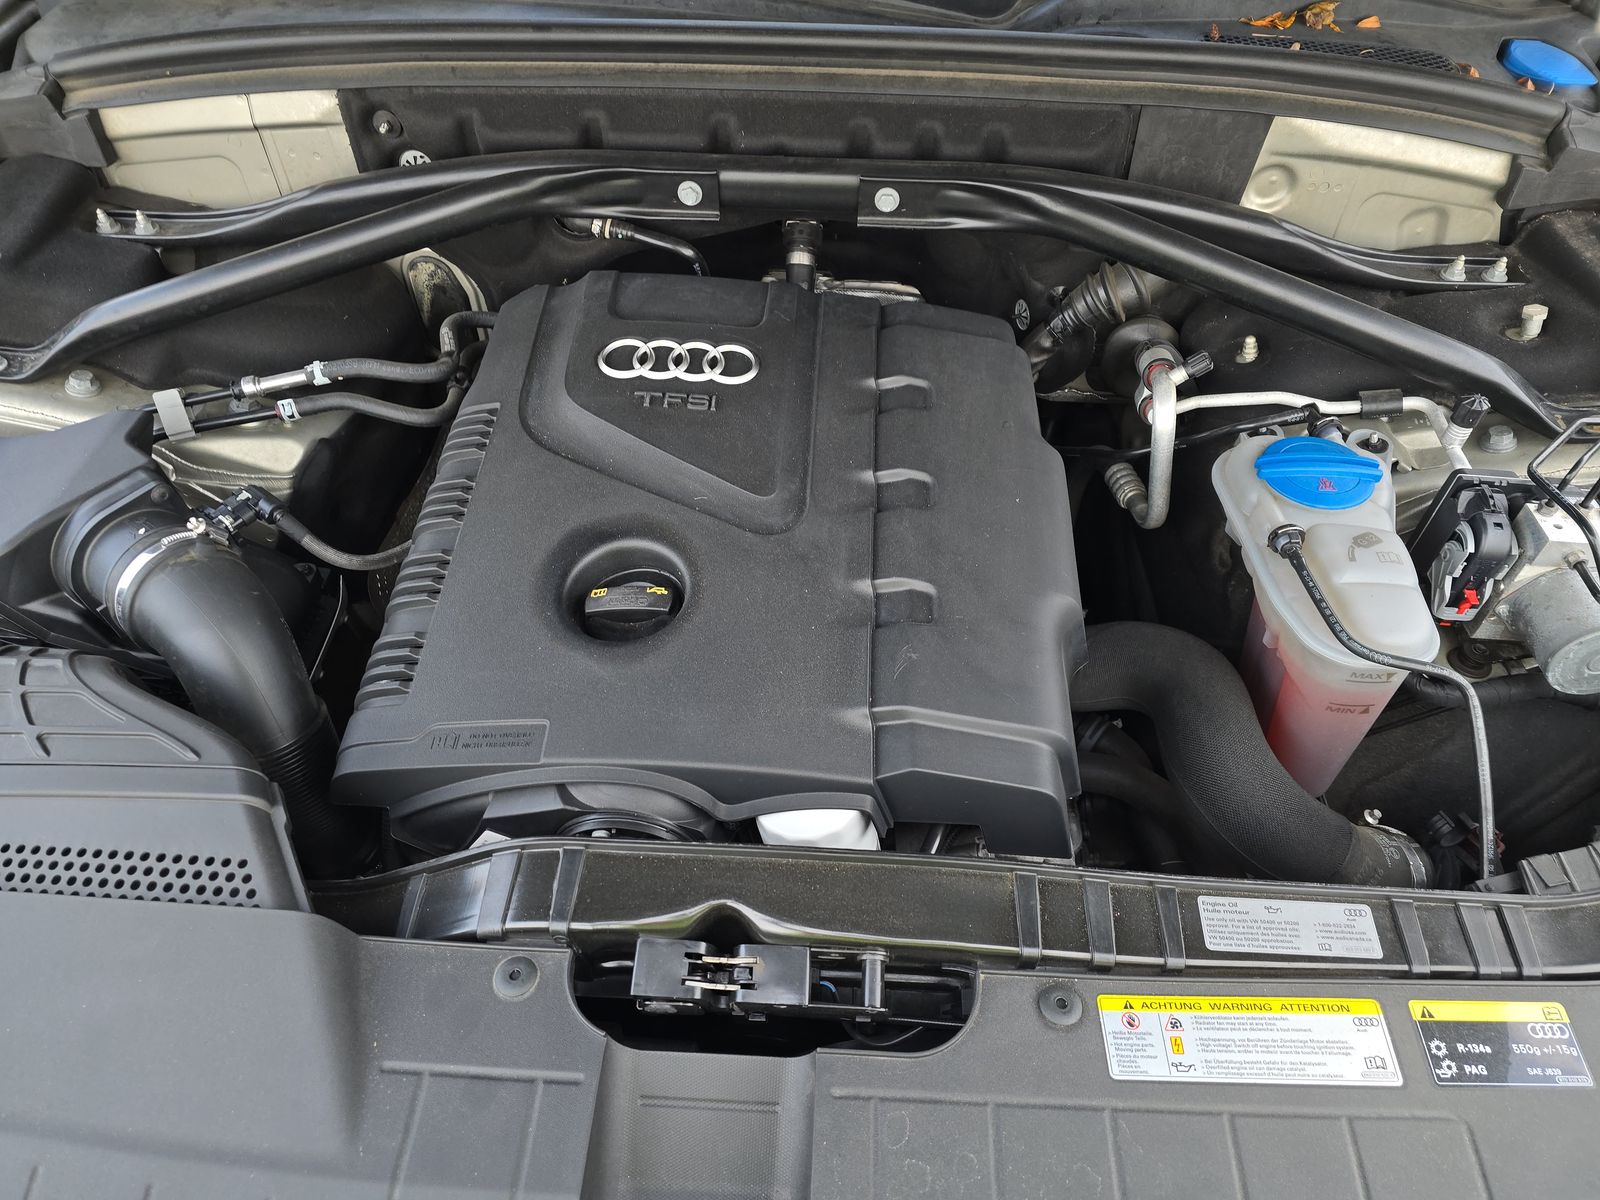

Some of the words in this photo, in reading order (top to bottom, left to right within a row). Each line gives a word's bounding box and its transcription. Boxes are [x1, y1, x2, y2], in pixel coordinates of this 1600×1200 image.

[634, 392, 716, 412] TFSI
[1350, 672, 1385, 680] MAX
[1325, 705, 1357, 714] MIN
[1202, 900, 1226, 908] Engine
[1140, 1001, 1202, 1010] ACHTUNG
[1208, 1002, 1272, 1011] WARNING
[1280, 1003, 1350, 1012] ATTENTION
[1456, 1043, 1492, 1054] R-134a
[1511, 1044, 1541, 1055] 550g
[1463, 1064, 1488, 1075] PAG
[1527, 1067, 1543, 1076] SAE
[1544, 1068, 1562, 1076] J639
